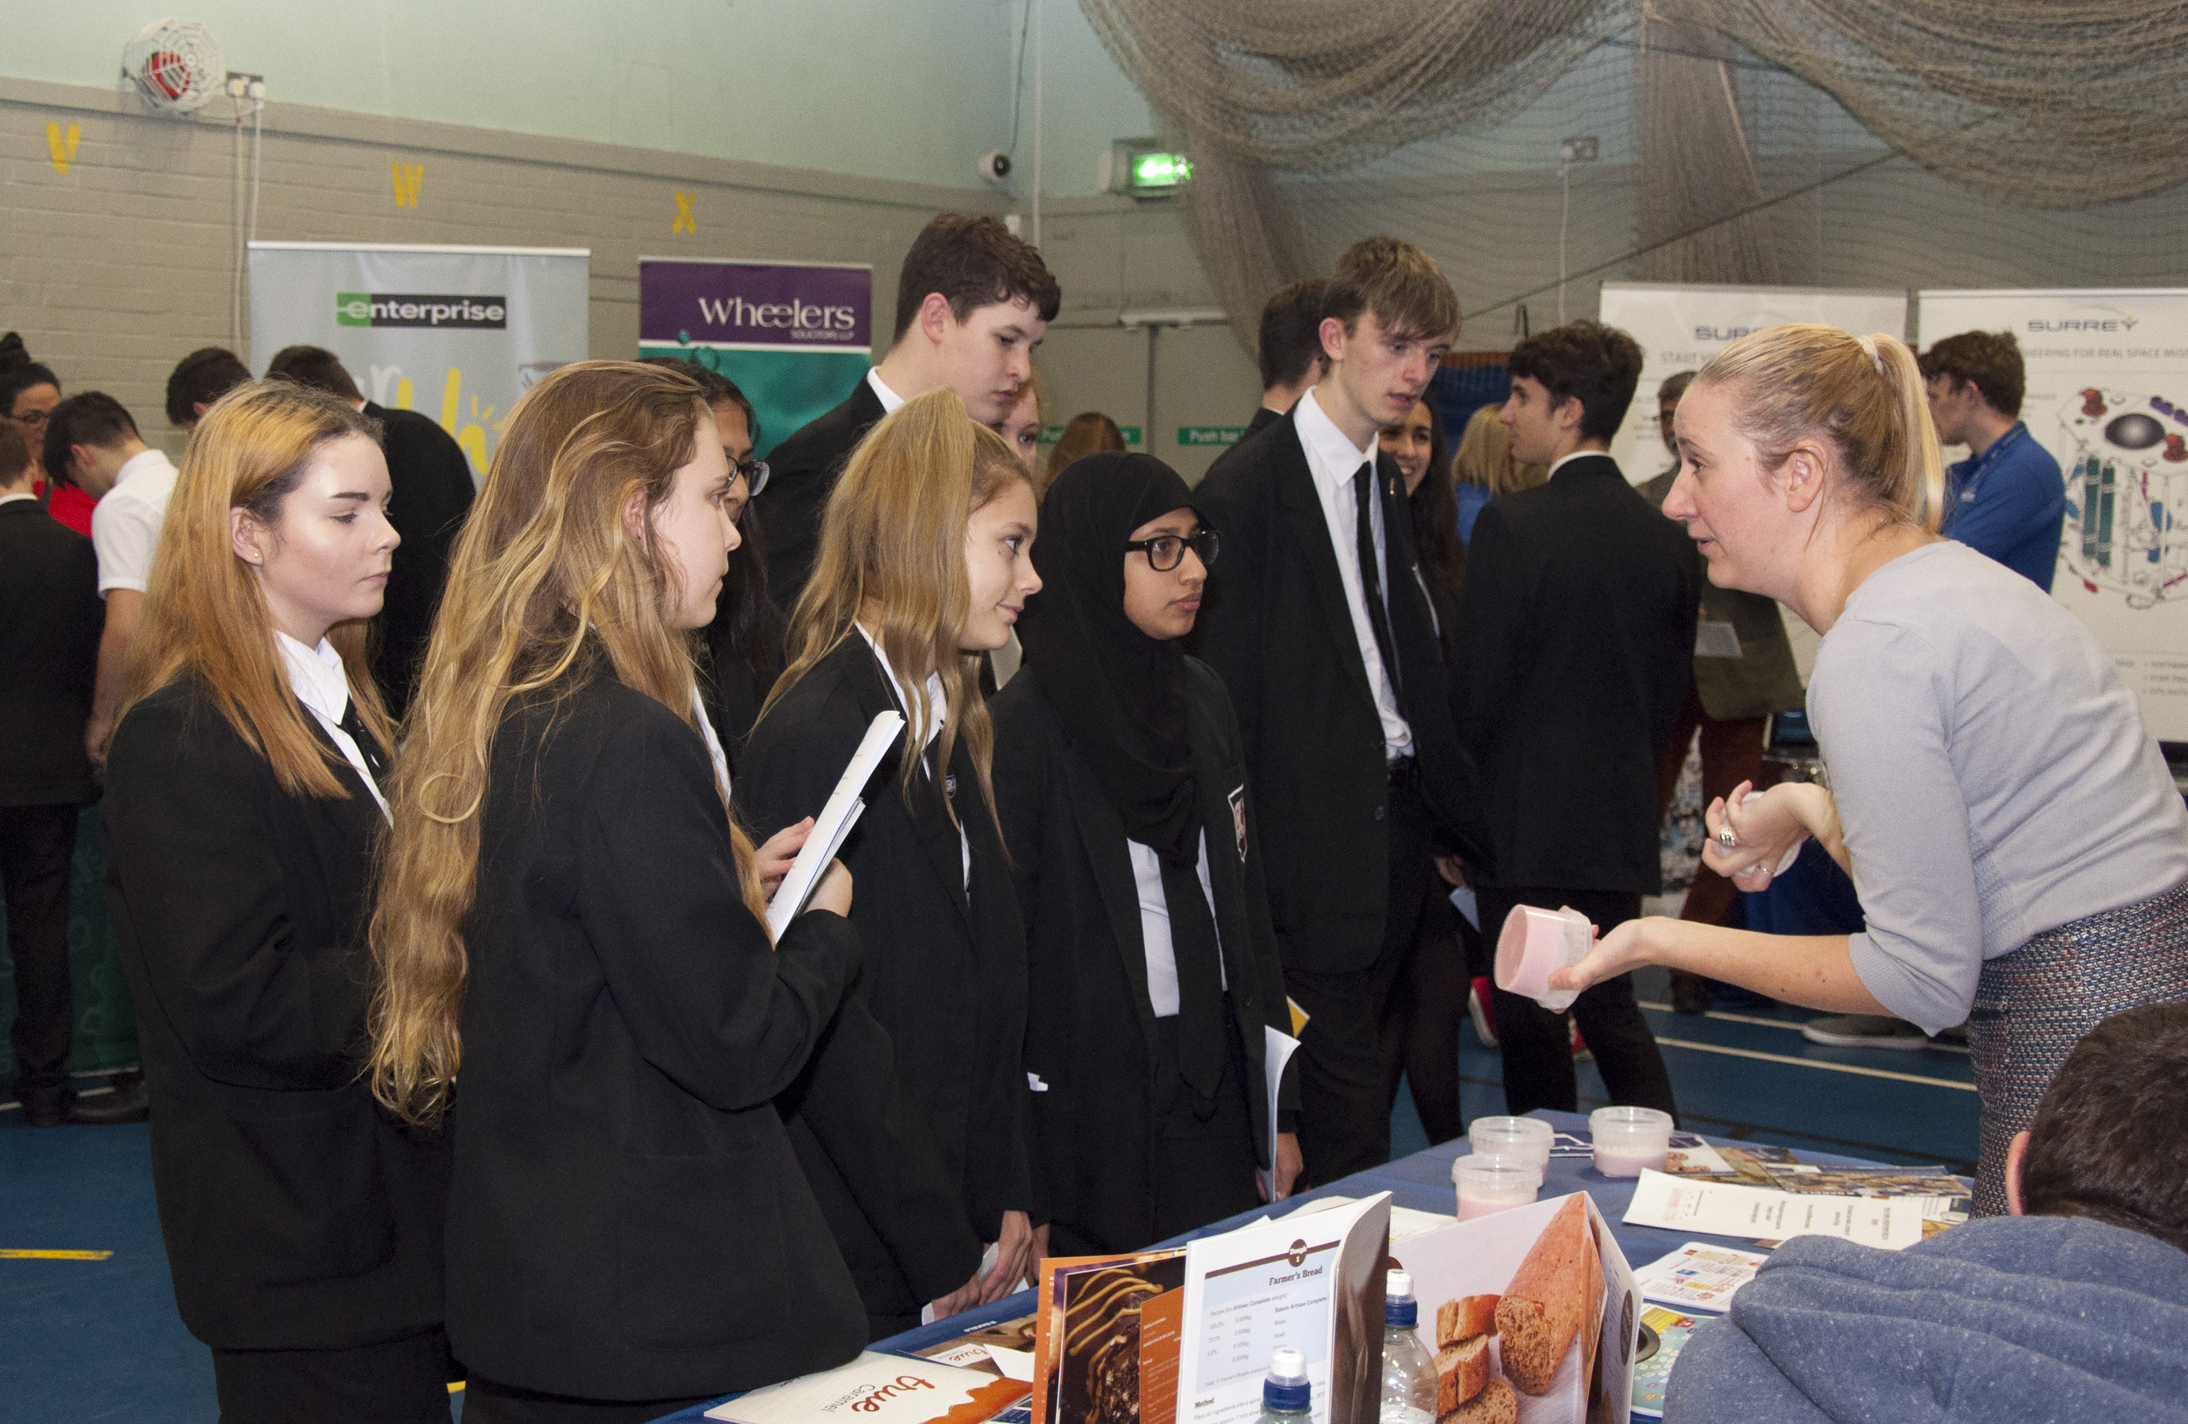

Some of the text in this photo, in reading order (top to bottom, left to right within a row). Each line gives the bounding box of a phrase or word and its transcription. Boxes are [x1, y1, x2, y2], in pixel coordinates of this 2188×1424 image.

[46, 122, 81, 174] V
[391, 160, 424, 208] W
[673, 191, 697, 234] X
[346, 299, 505, 325] enterprise
[698, 296, 856, 330] Wheelers
[2027, 318, 2138, 332] SURREY
[1269, 1265, 1323, 1286] Farmer's Bread
[822, 1384, 876, 1413] Caramel
[852, 1376, 936, 1412] true
[1194, 1397, 1215, 1409] Method
